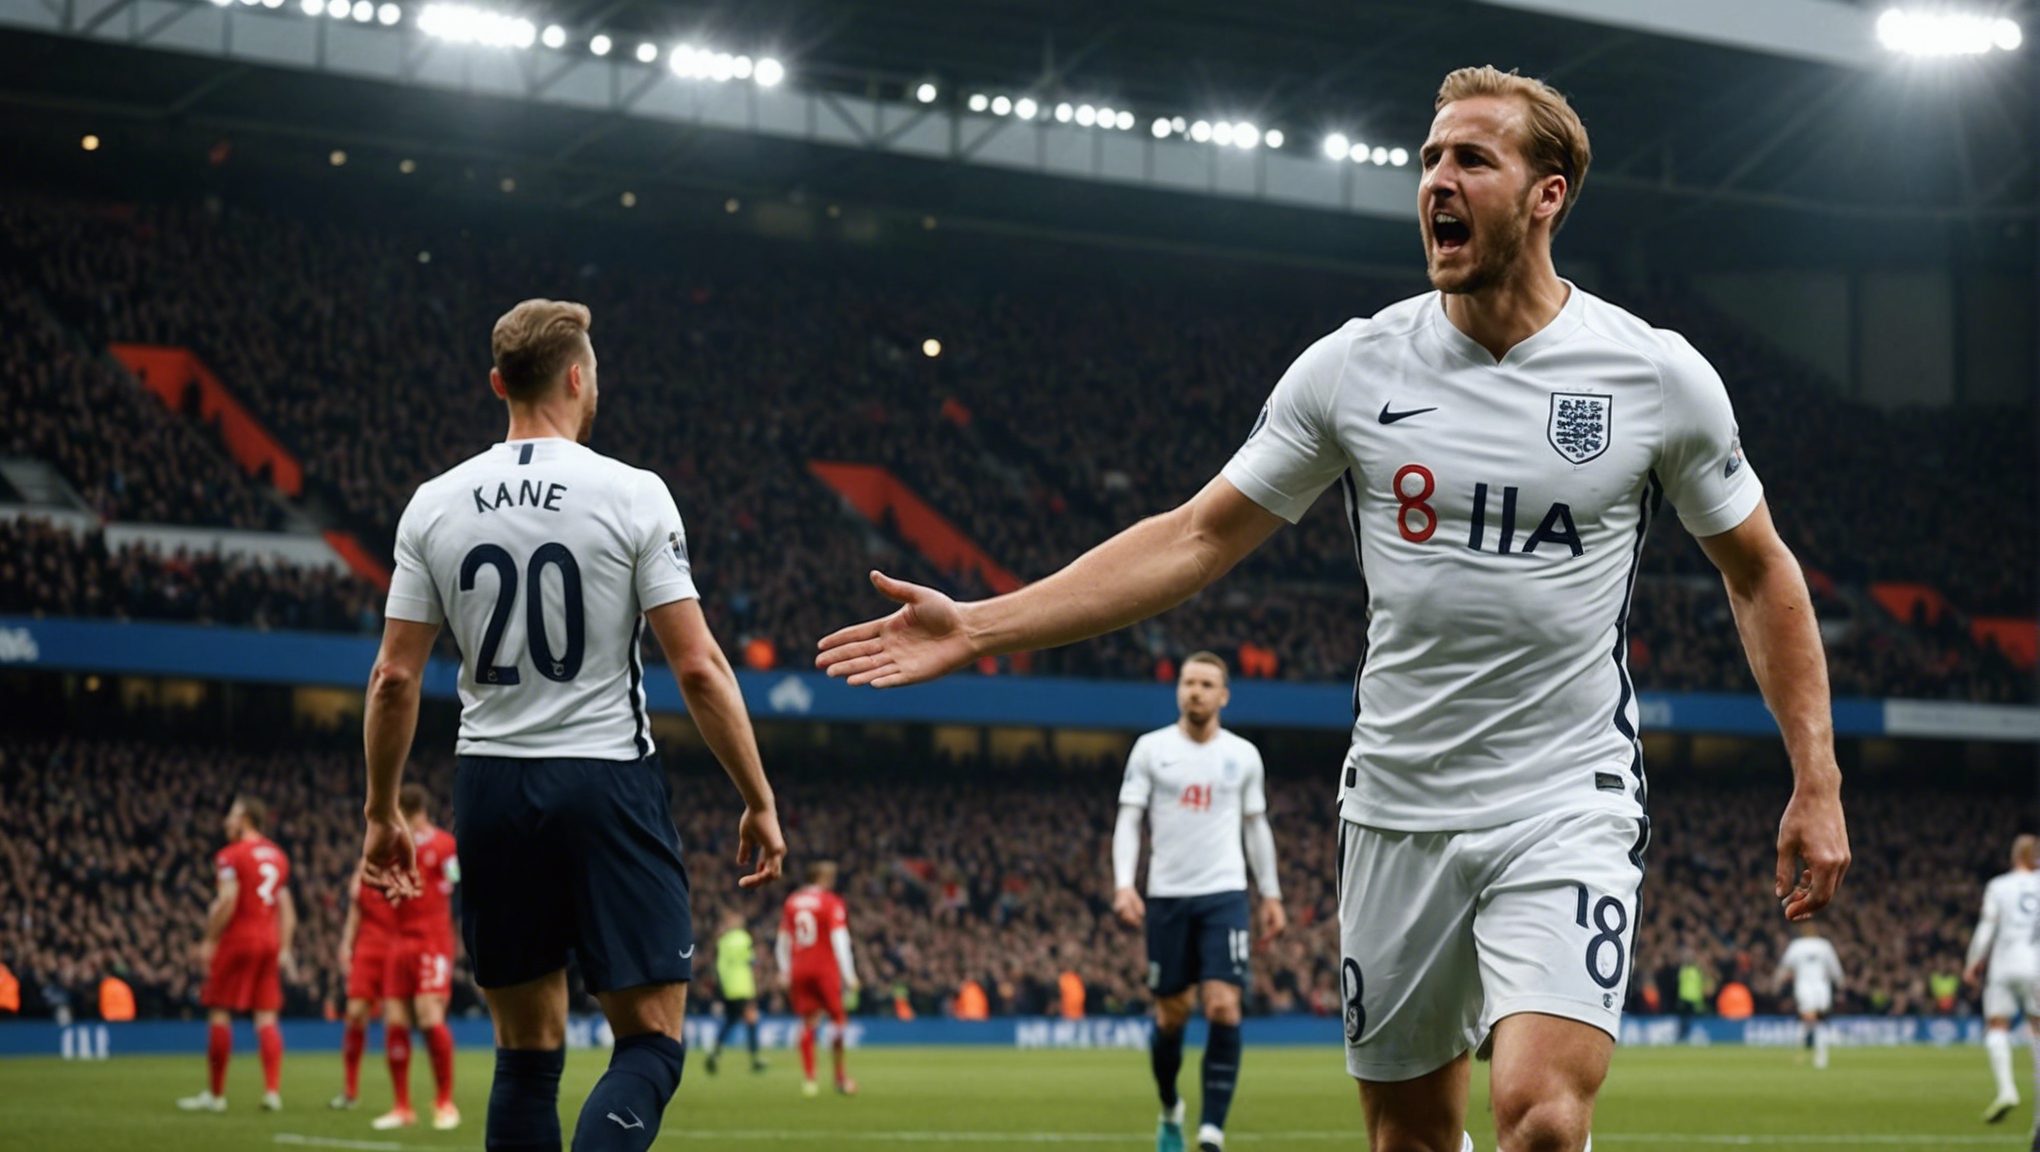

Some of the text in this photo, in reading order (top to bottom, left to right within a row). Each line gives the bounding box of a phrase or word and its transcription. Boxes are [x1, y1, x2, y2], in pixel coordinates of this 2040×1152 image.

[472, 479, 568, 514] KANE
[1392, 464, 1438, 543] 8
[460, 541, 586, 686] 20
[1575, 884, 1628, 990] 18
